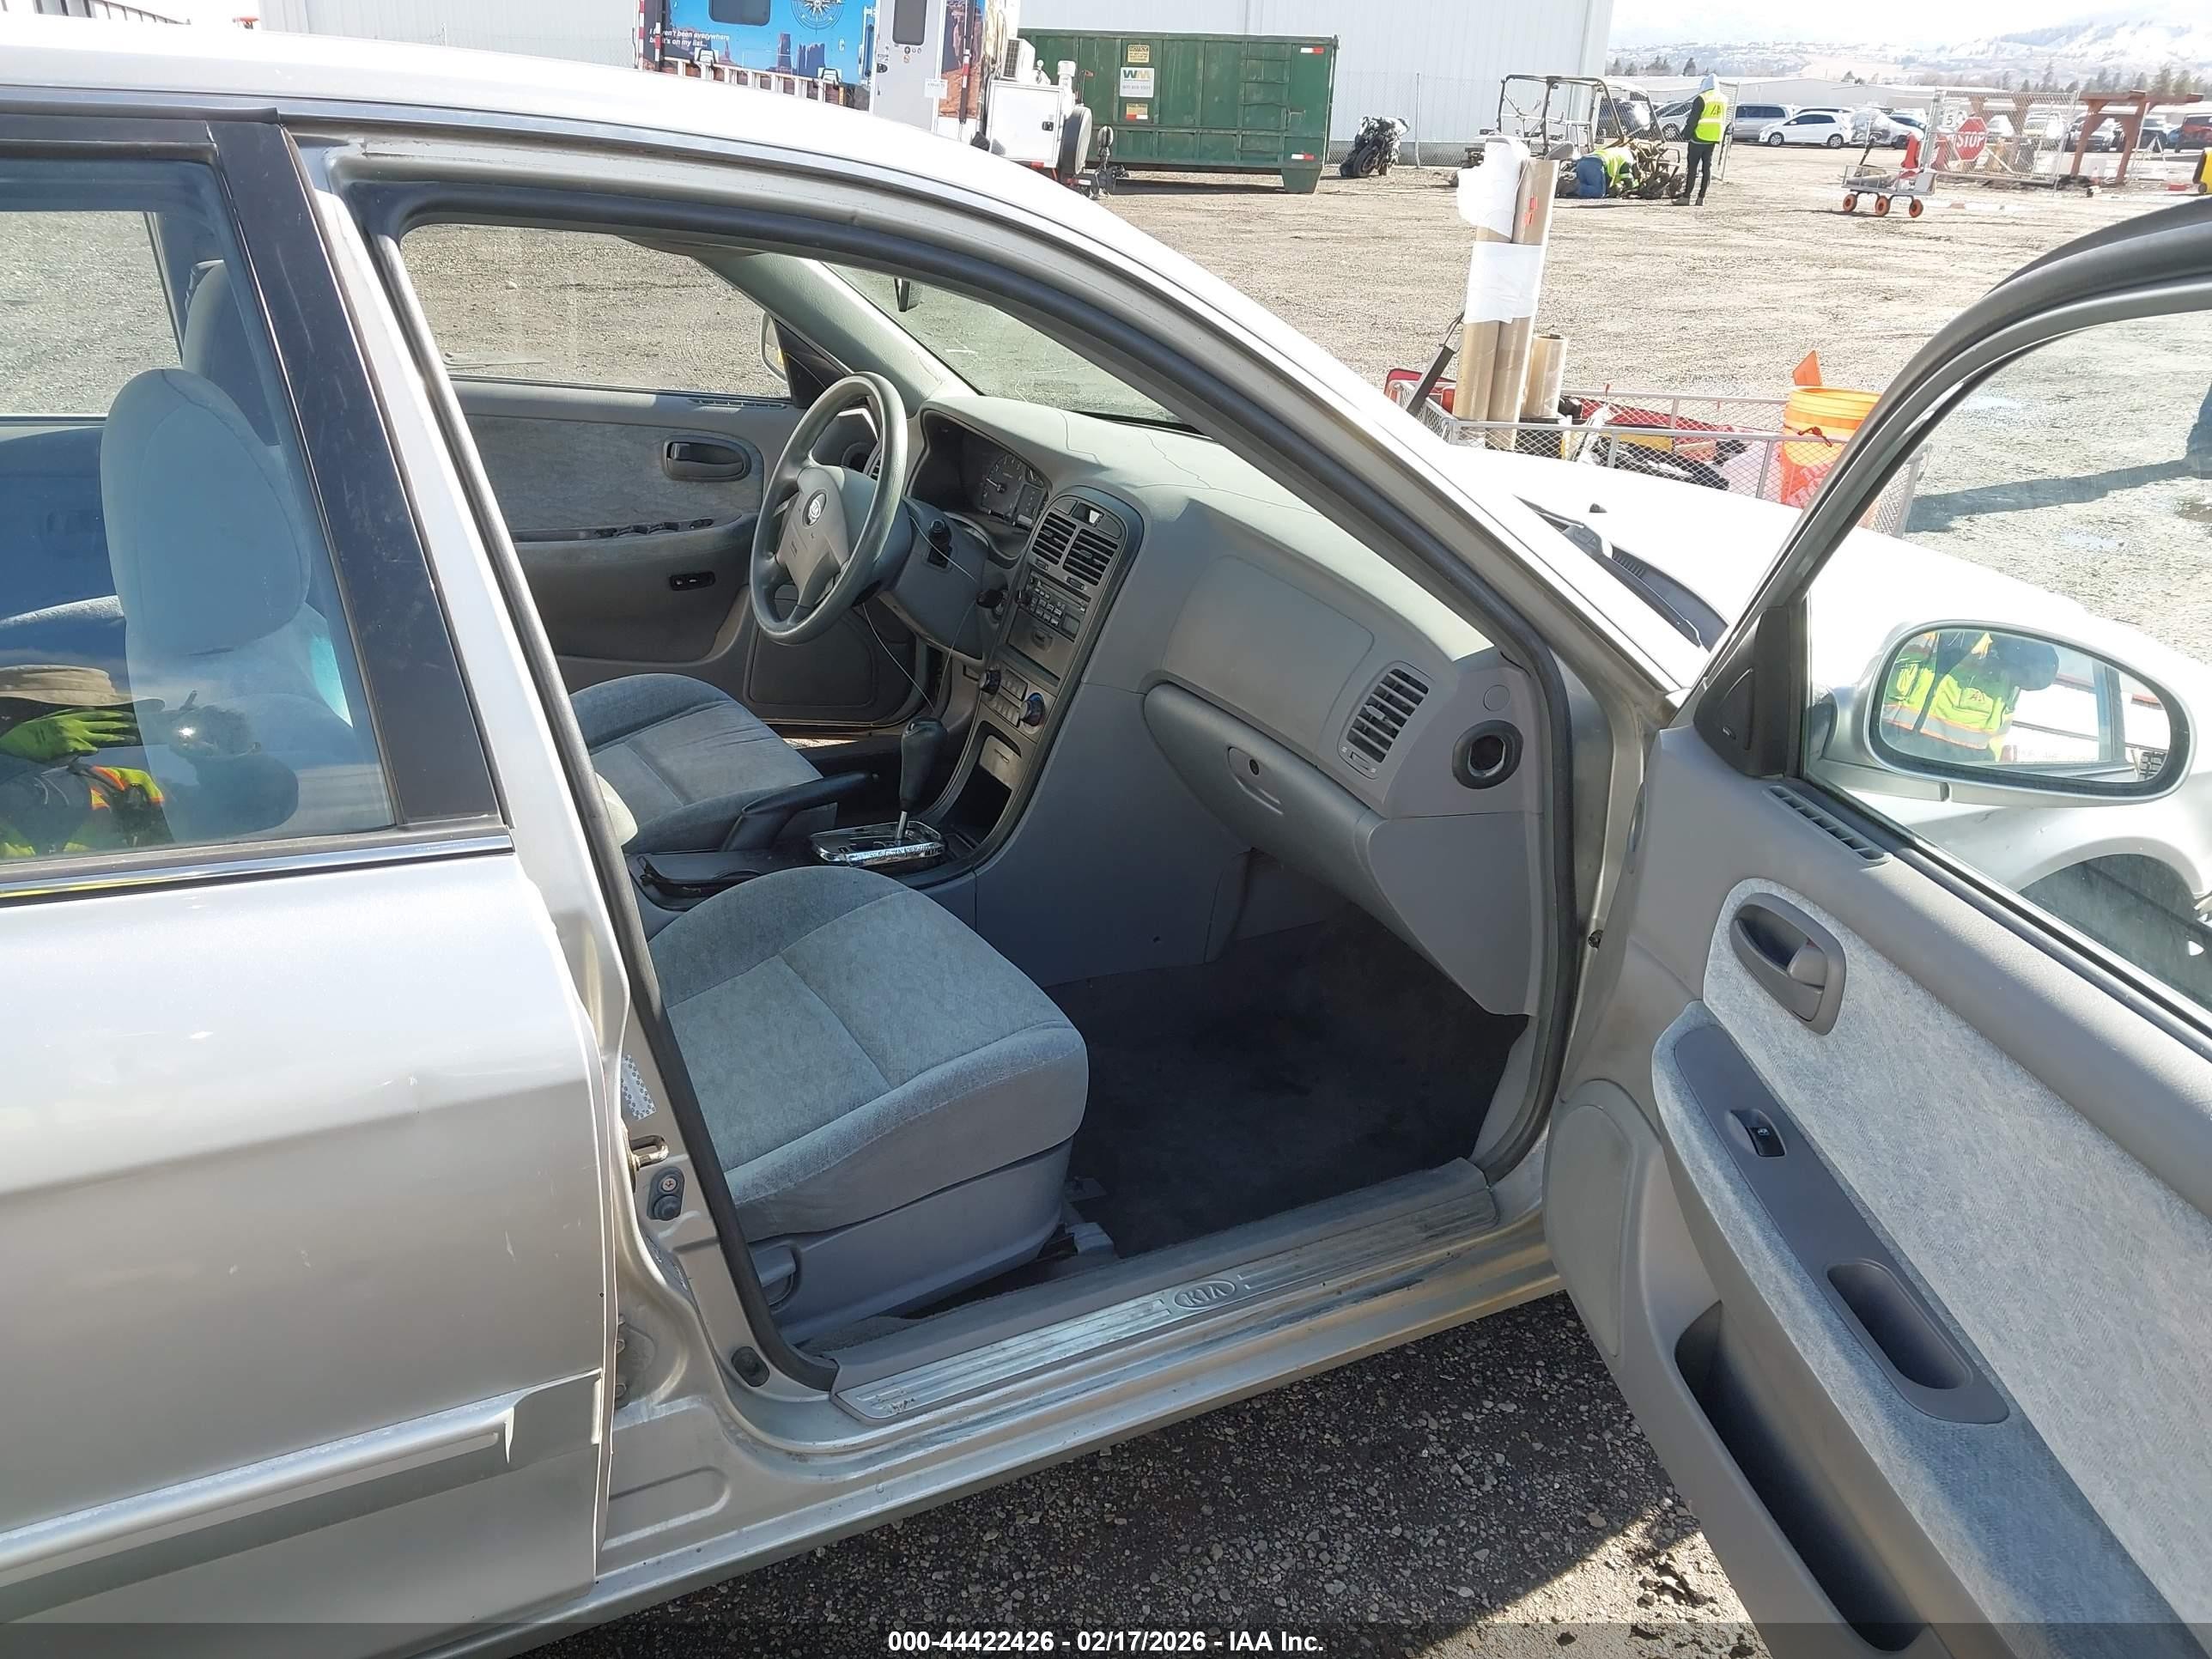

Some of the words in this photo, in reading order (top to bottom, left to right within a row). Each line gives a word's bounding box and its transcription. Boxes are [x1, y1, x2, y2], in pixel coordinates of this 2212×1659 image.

[678, 29, 693, 38] been
[1123, 70, 1150, 78] WM
[1956, 132, 1985, 147] STOP
[1182, 1285, 1228, 1306] KIA
